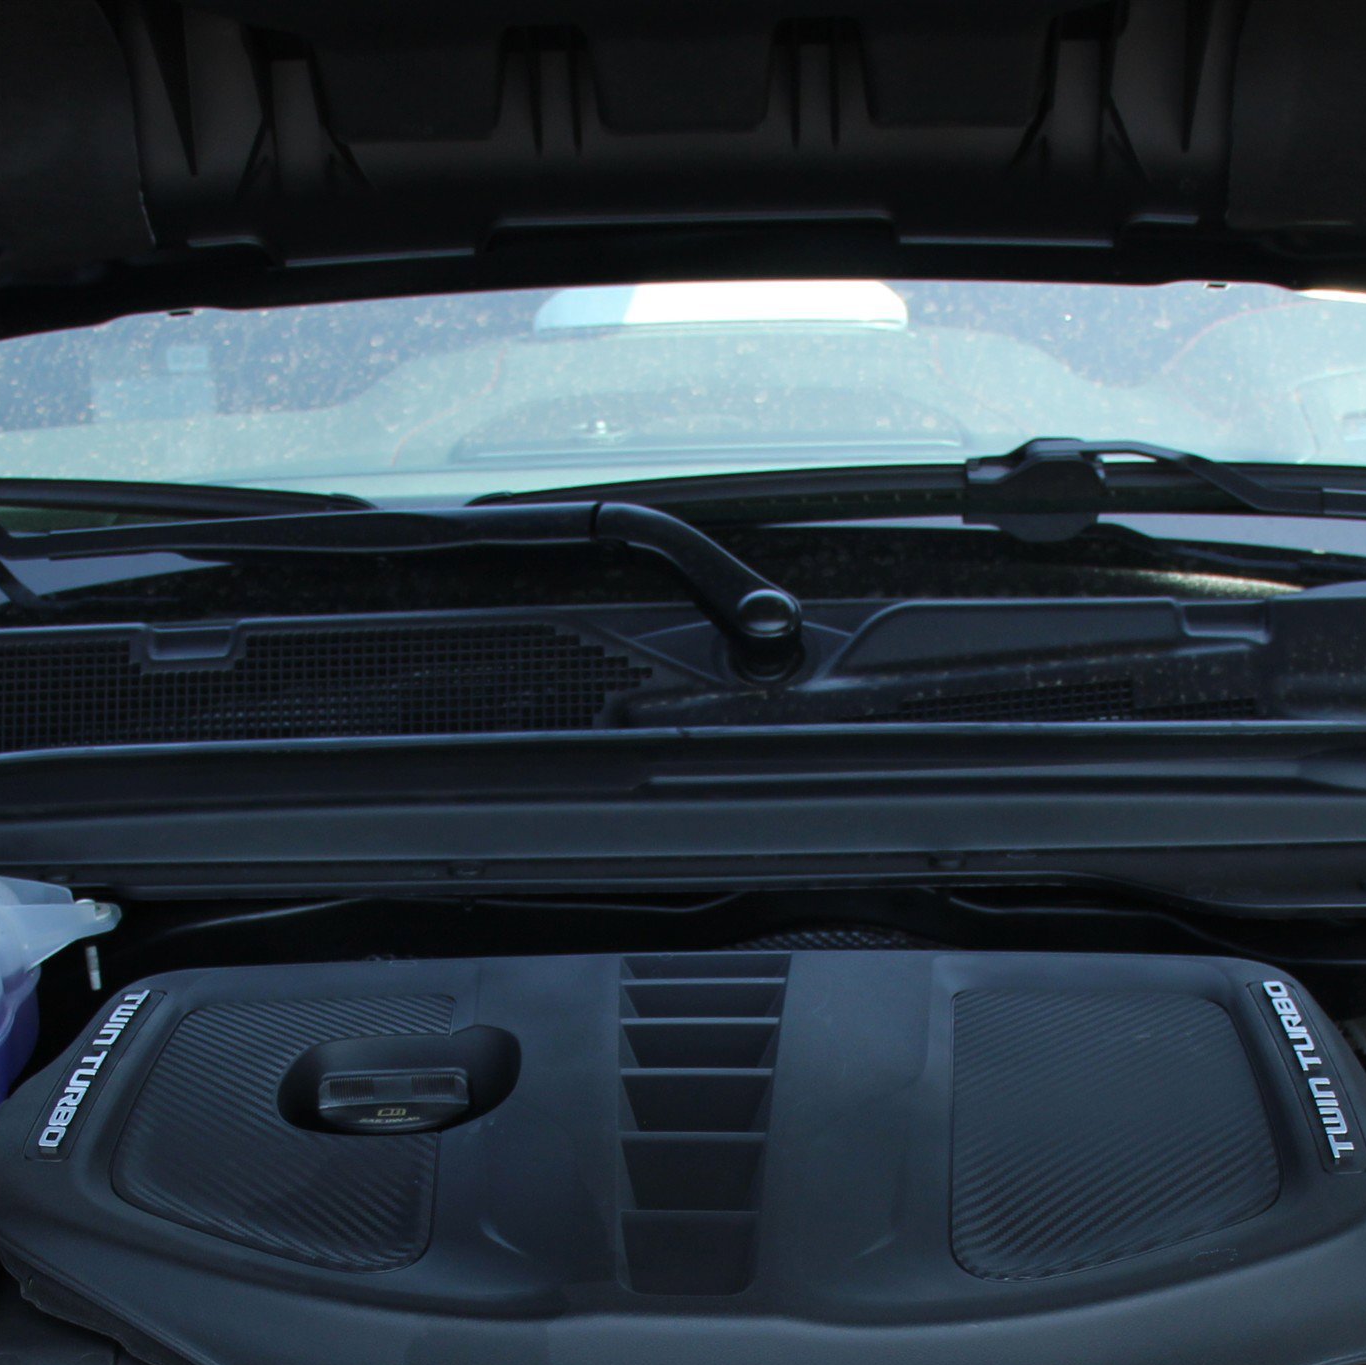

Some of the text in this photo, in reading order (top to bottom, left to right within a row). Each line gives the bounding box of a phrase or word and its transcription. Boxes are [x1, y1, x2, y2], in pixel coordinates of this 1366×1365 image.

[37, 989, 151, 1147] TWIN TURBO
[1262, 980, 1355, 1160] TWIN TURBO
